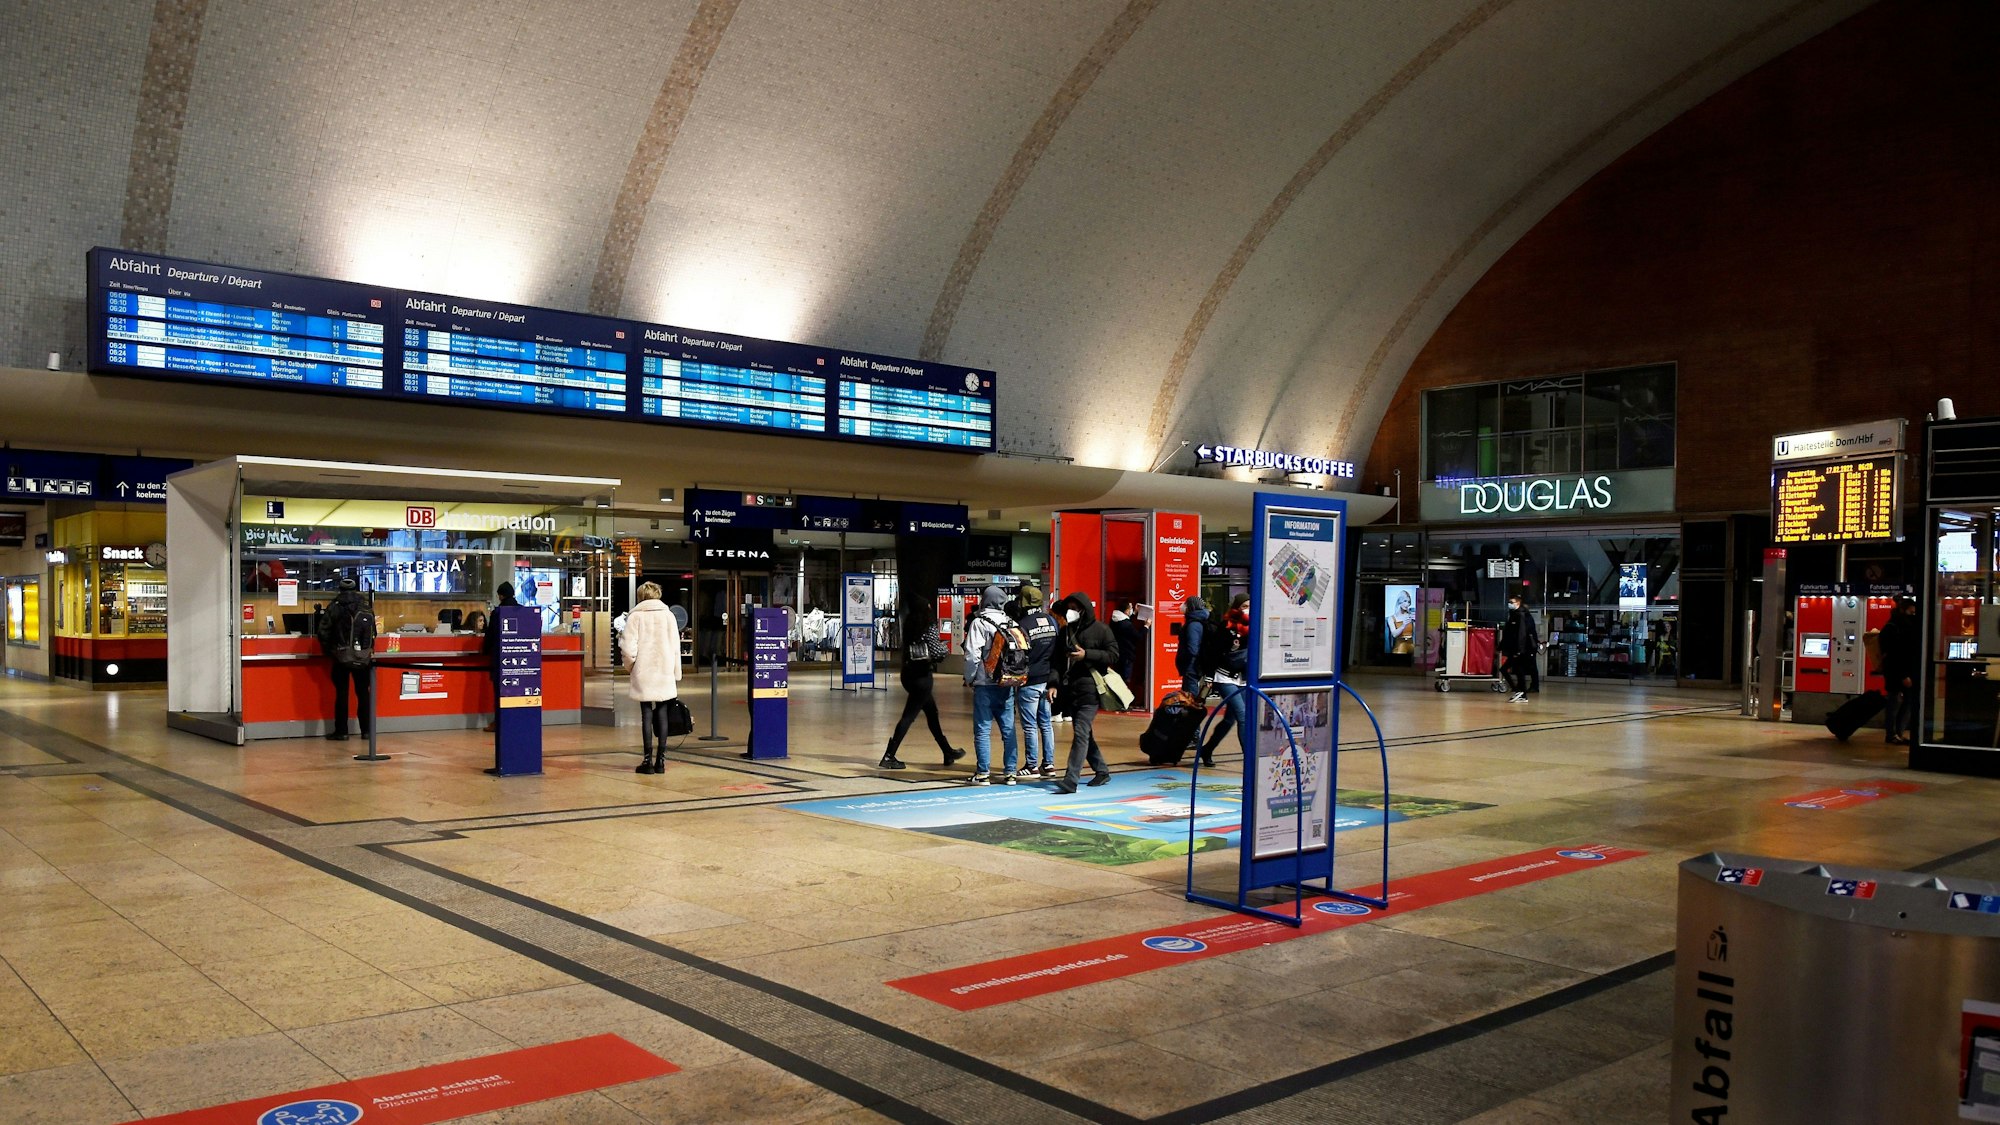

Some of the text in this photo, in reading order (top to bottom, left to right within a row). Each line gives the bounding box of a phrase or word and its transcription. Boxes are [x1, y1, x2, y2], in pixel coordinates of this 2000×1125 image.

[110, 257, 161, 276] Abfahrt
[167, 267, 219, 284] Departure
[228, 274, 262, 290] Départ
[168, 288, 181, 296] Über
[109, 298, 127, 306] 06:10
[109, 305, 127, 313] 06:20
[405, 297, 447, 314] Abfahrt
[451, 306, 492, 320] Departure
[498, 311, 526, 324] Départ
[109, 316, 127, 324] 06:21
[109, 323, 127, 331] 06:21
[109, 341, 127, 349] 06:24
[644, 329, 678, 344] Abfahrt
[681, 336, 716, 349] Departure
[720, 341, 743, 352] Départ
[109, 348, 127, 357] 06:24
[109, 356, 127, 364] 06:24
[840, 356, 869, 369] Abfahrt
[871, 361, 900, 373] Departure
[904, 366, 924, 376] Départ
[1793, 440, 1834, 452] Haltestelle
[1836, 433, 1874, 447] Dom/Hbf
[1215, 445, 1355, 478] STARBUCKS COFFEE
[147, 482, 160, 491] den
[136, 491, 167, 499] koelnme
[1460, 475, 1612, 514] DOUGLAS
[756, 495, 764, 505] S
[721, 509, 737, 518] Zügen
[409, 508, 556, 531] DB Information
[704, 516, 732, 524] koelnmesse
[1284, 520, 1321, 531] INFORMATION
[244, 528, 265, 541] BIG
[704, 526, 710, 538] 1
[1812, 531, 1827, 541] Linie
[1159, 536, 1196, 545] Desinfektions-
[103, 547, 144, 560] Snack
[705, 549, 770, 559] ETERNA
[1168, 545, 1187, 553] station
[396, 559, 462, 574] ETERNA
[967, 559, 1008, 568] epäckCenter
[950, 952, 1128, 996] gemeinsamgehtdas.de
[1691, 969, 1735, 1125] Abfall
[372, 1074, 503, 1105] Abstand schützt!
[378, 1079, 516, 1110] Distance saves lives.
